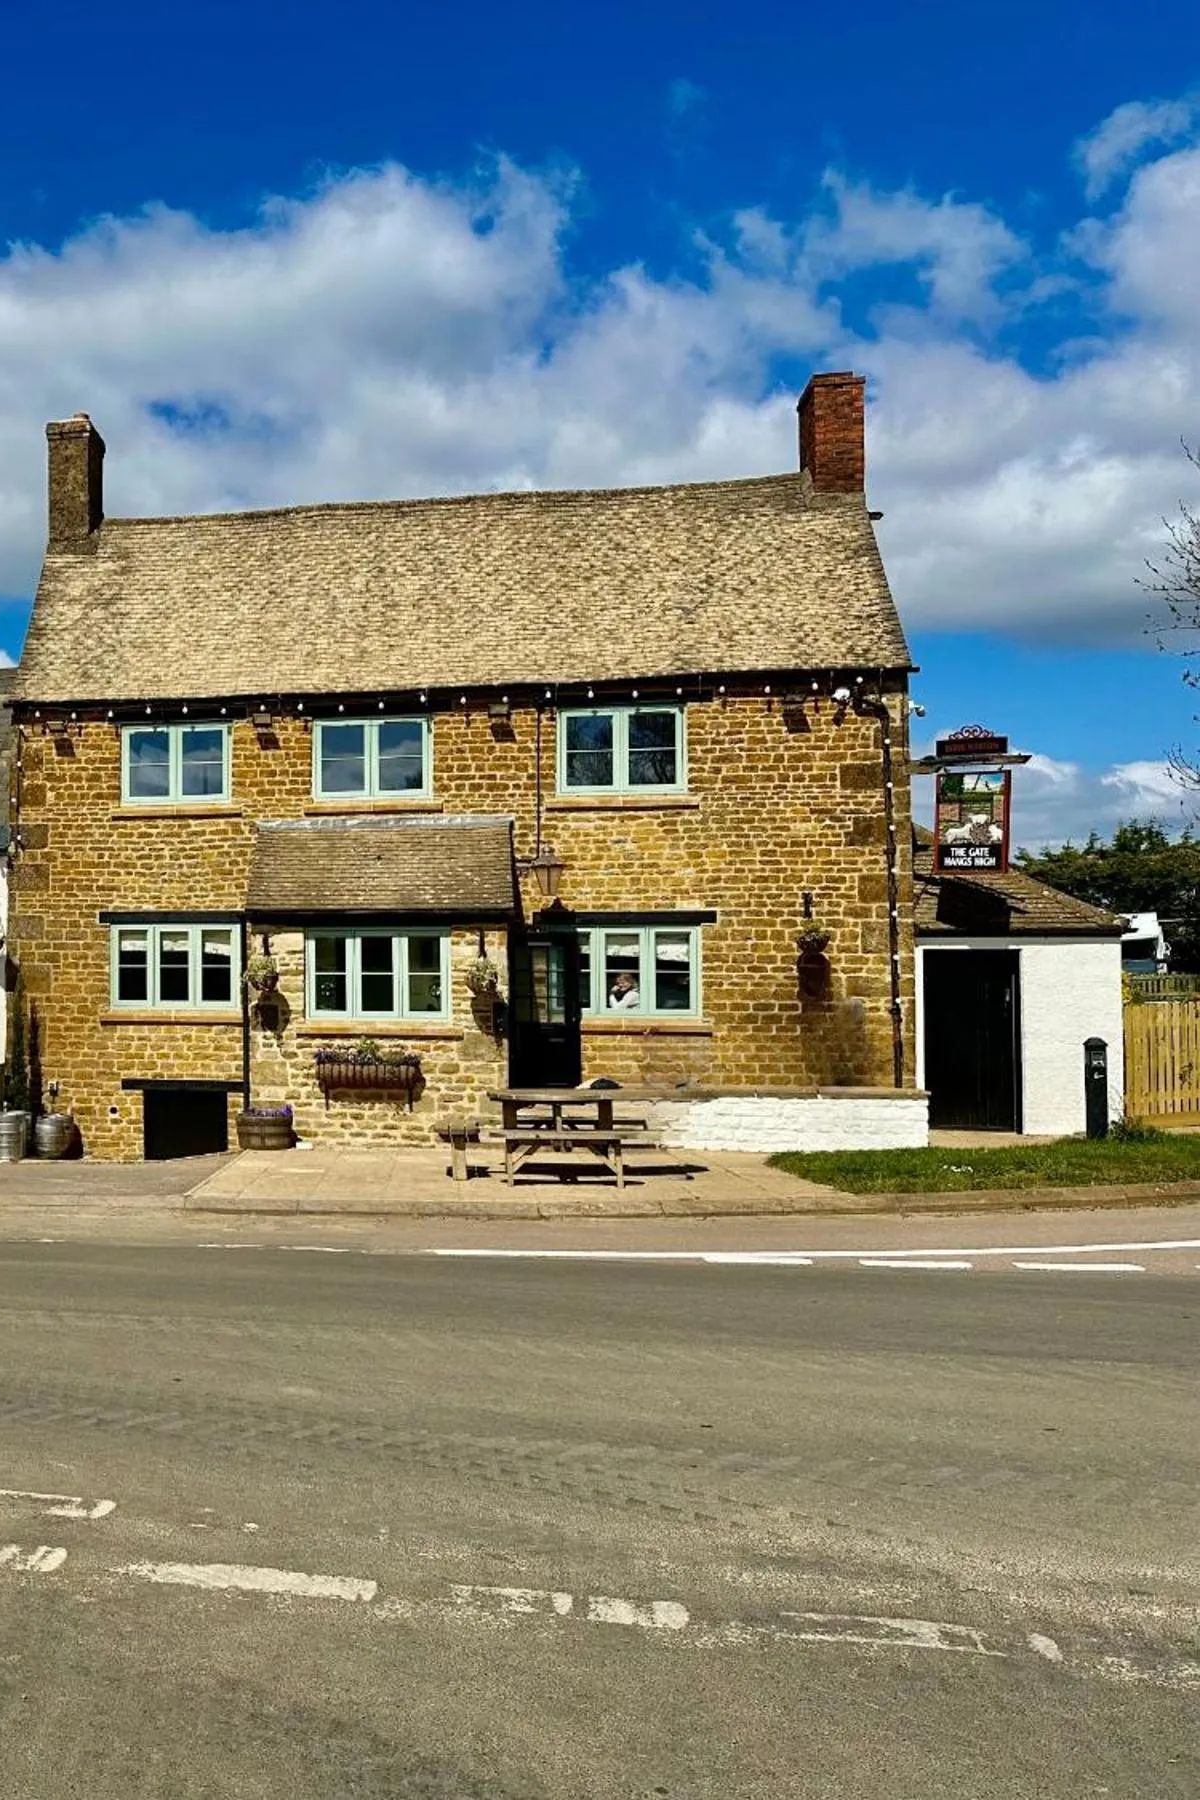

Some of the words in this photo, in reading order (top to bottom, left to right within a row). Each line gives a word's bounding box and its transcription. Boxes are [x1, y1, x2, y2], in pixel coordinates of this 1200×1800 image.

[950, 847, 967, 857] THE
[968, 847, 990, 857] GATE
[943, 857, 972, 867] HANGS
[974, 856, 996, 867] HIGH
